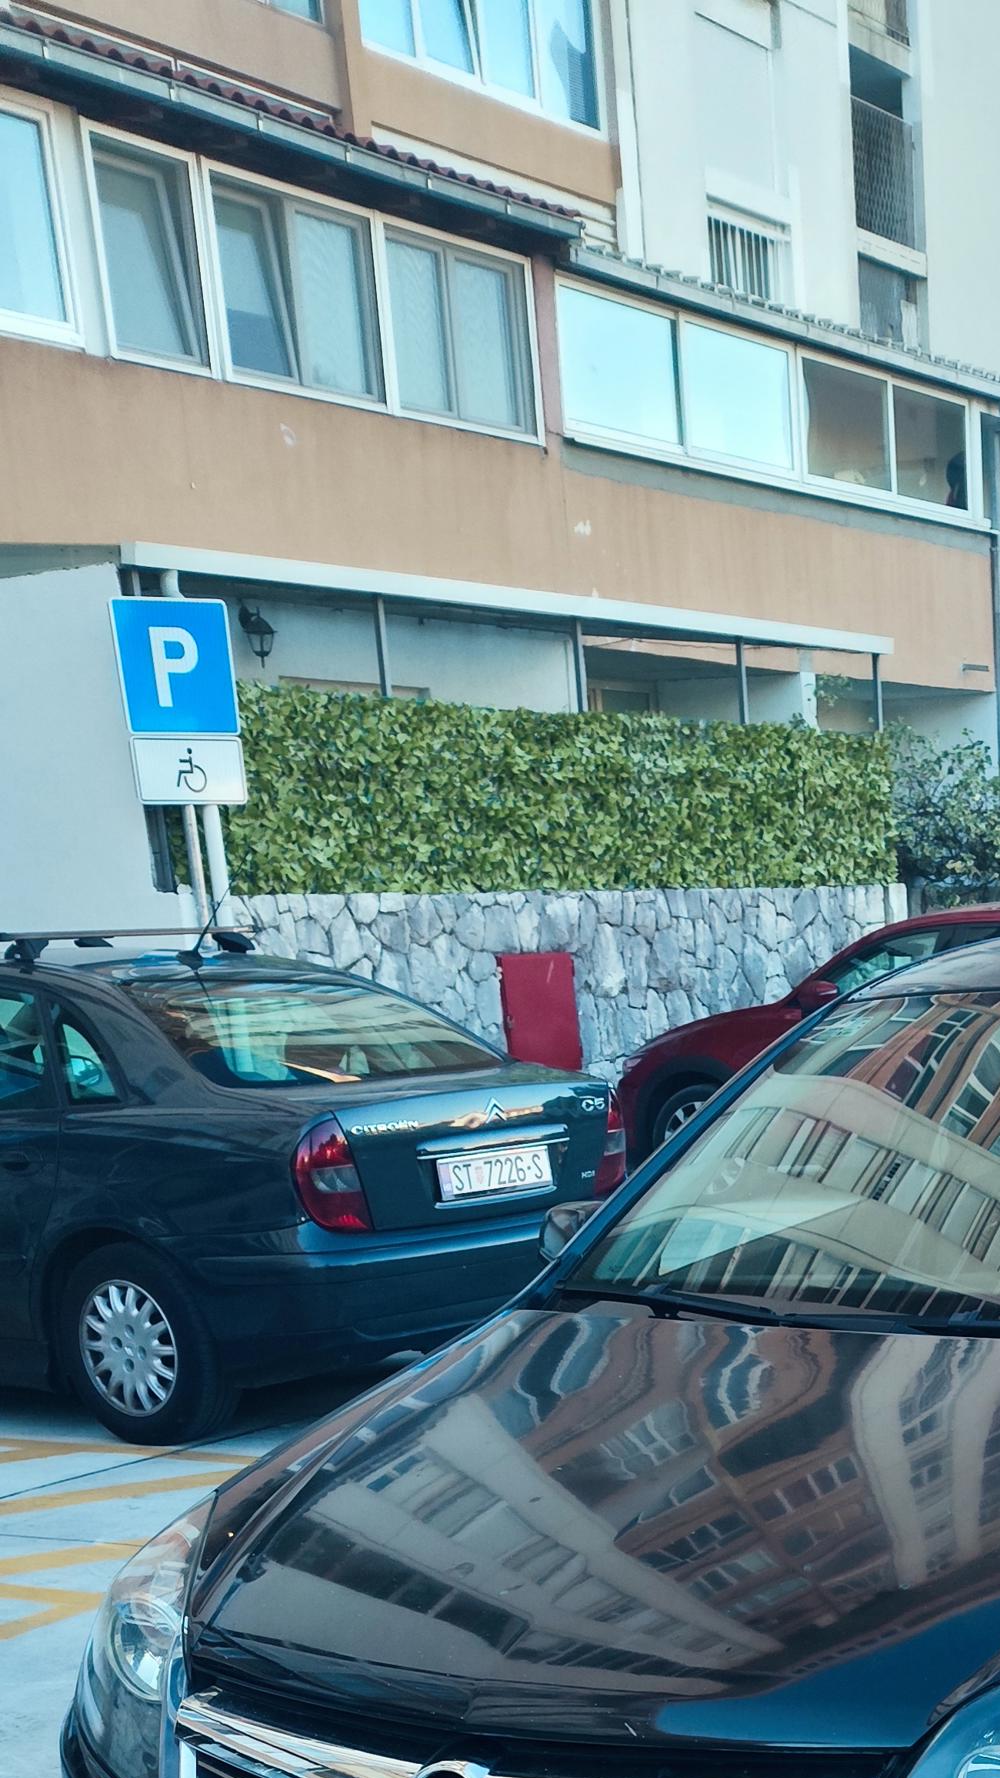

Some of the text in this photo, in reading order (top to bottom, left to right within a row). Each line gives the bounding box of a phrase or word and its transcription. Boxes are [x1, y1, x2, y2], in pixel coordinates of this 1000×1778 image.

[148, 626, 198, 707] P
[582, 1097, 605, 1111] C5
[452, 1163, 474, 1192] ST
